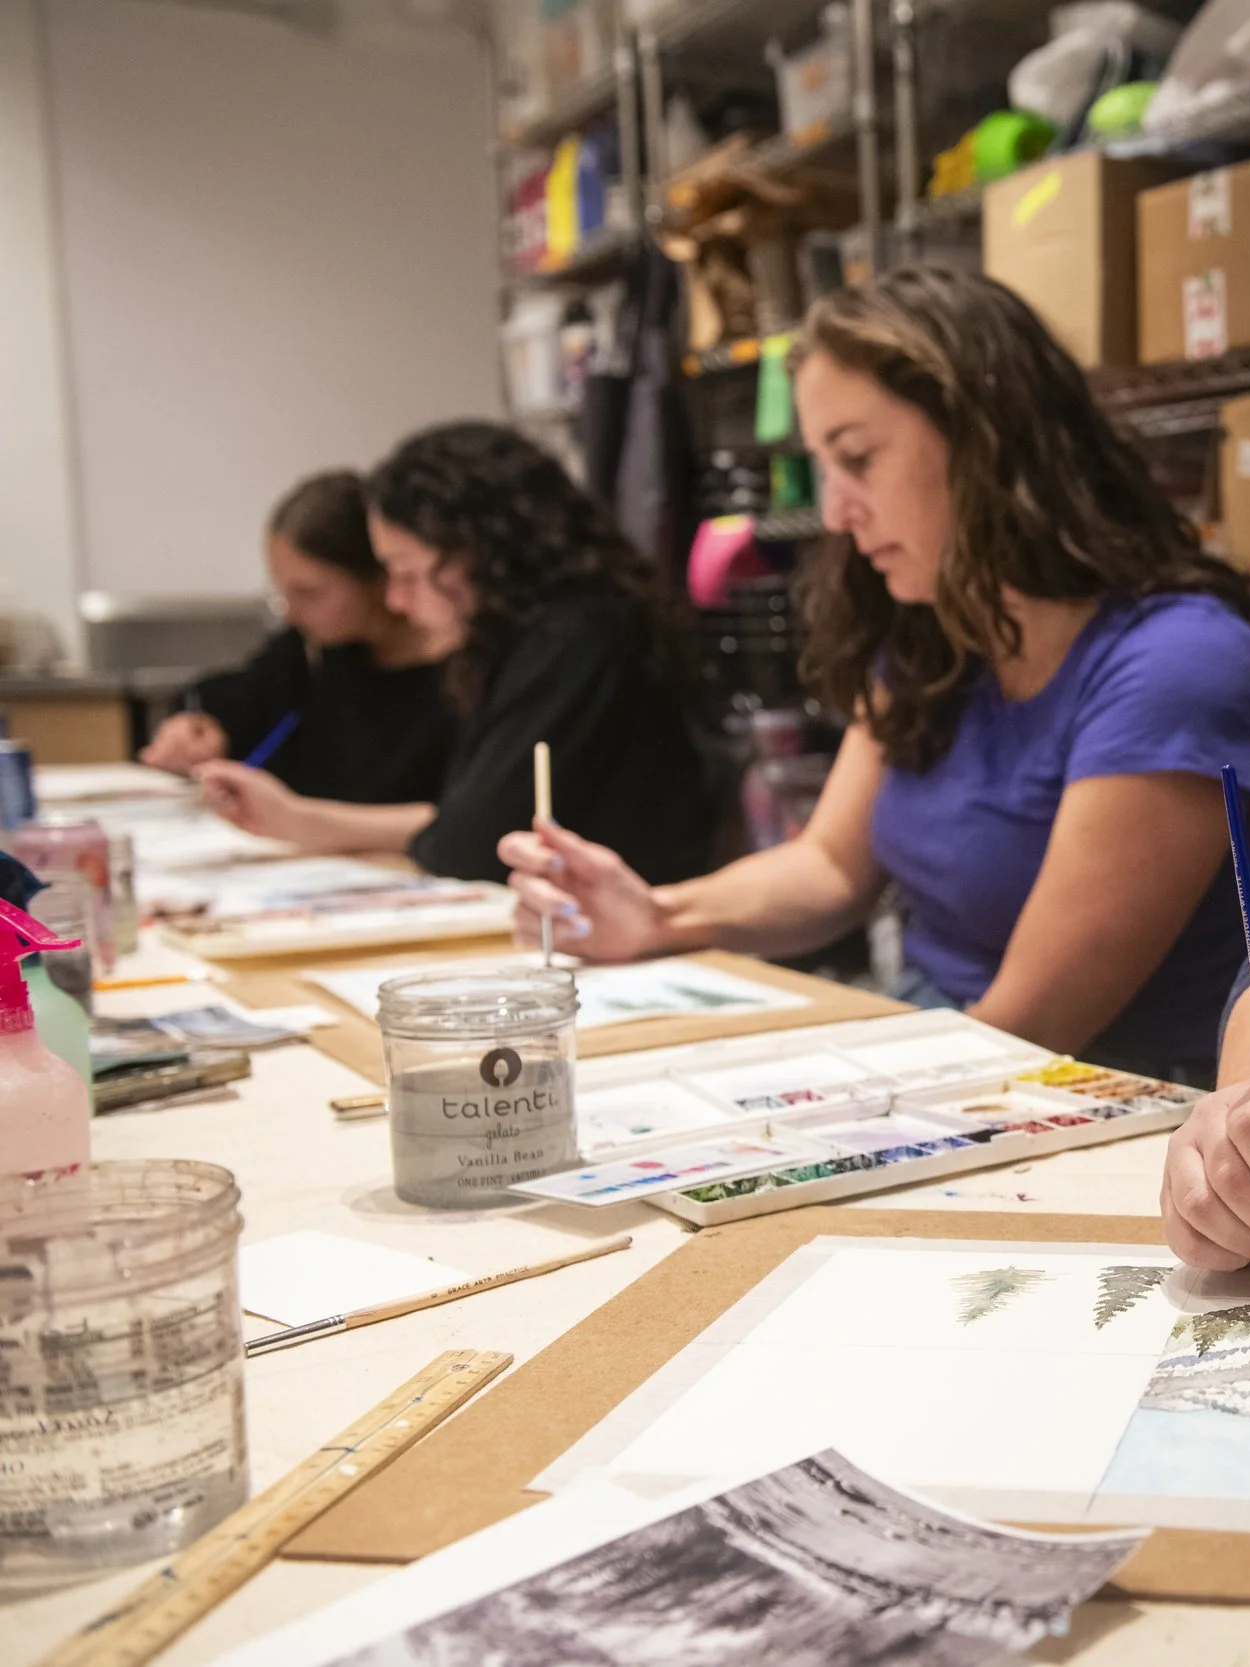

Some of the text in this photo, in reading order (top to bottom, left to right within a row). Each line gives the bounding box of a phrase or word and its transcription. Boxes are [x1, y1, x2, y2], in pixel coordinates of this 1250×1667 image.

[442, 1090, 554, 1119] talenti
[485, 1122, 520, 1149] gelato
[457, 1149, 544, 1168] Vanilla Bean
[447, 1282, 471, 1295] GRACE
